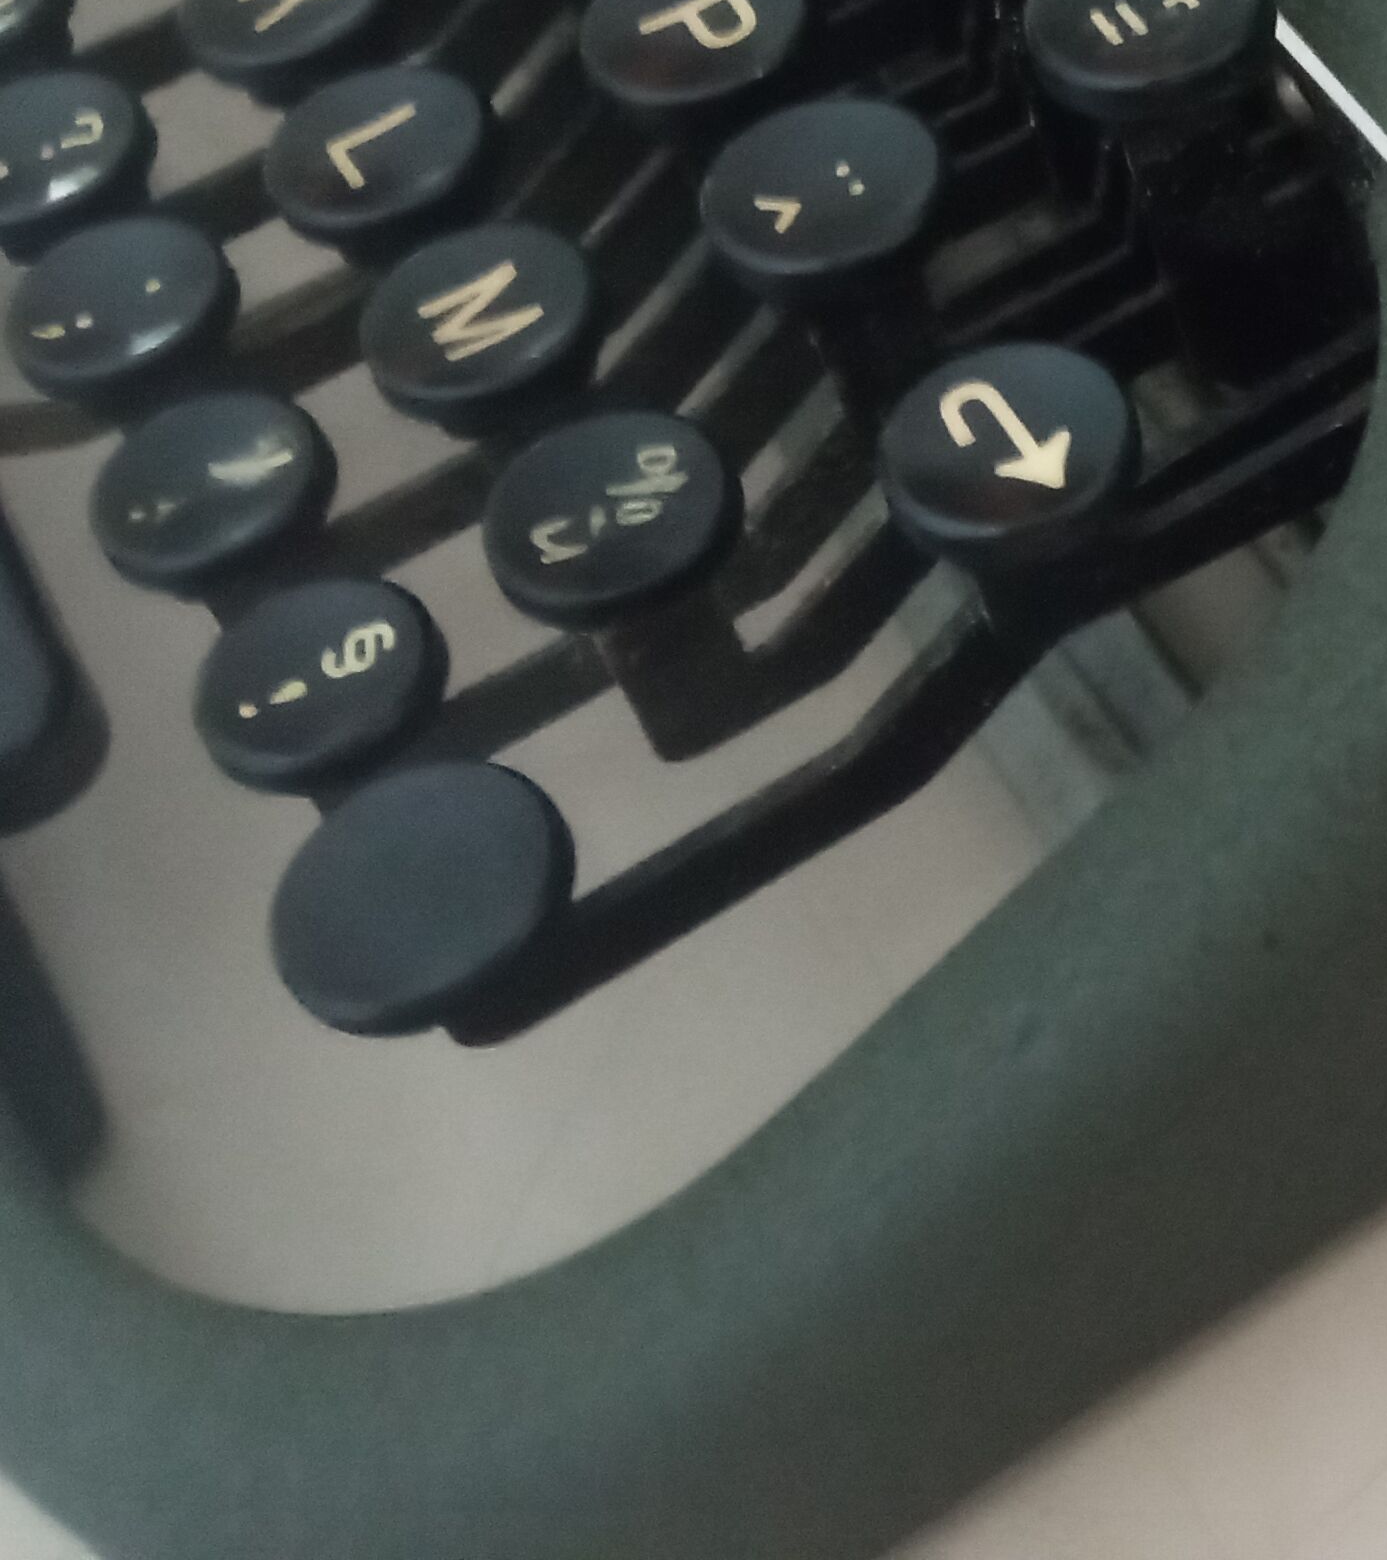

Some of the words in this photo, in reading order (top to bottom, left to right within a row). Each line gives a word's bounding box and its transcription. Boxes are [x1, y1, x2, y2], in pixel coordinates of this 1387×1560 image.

[1091, 2, 1148, 45] =
[327, 102, 416, 188] L
[418, 261, 544, 360] M
[602, 444, 687, 525] %
[321, 622, 394, 678] §
